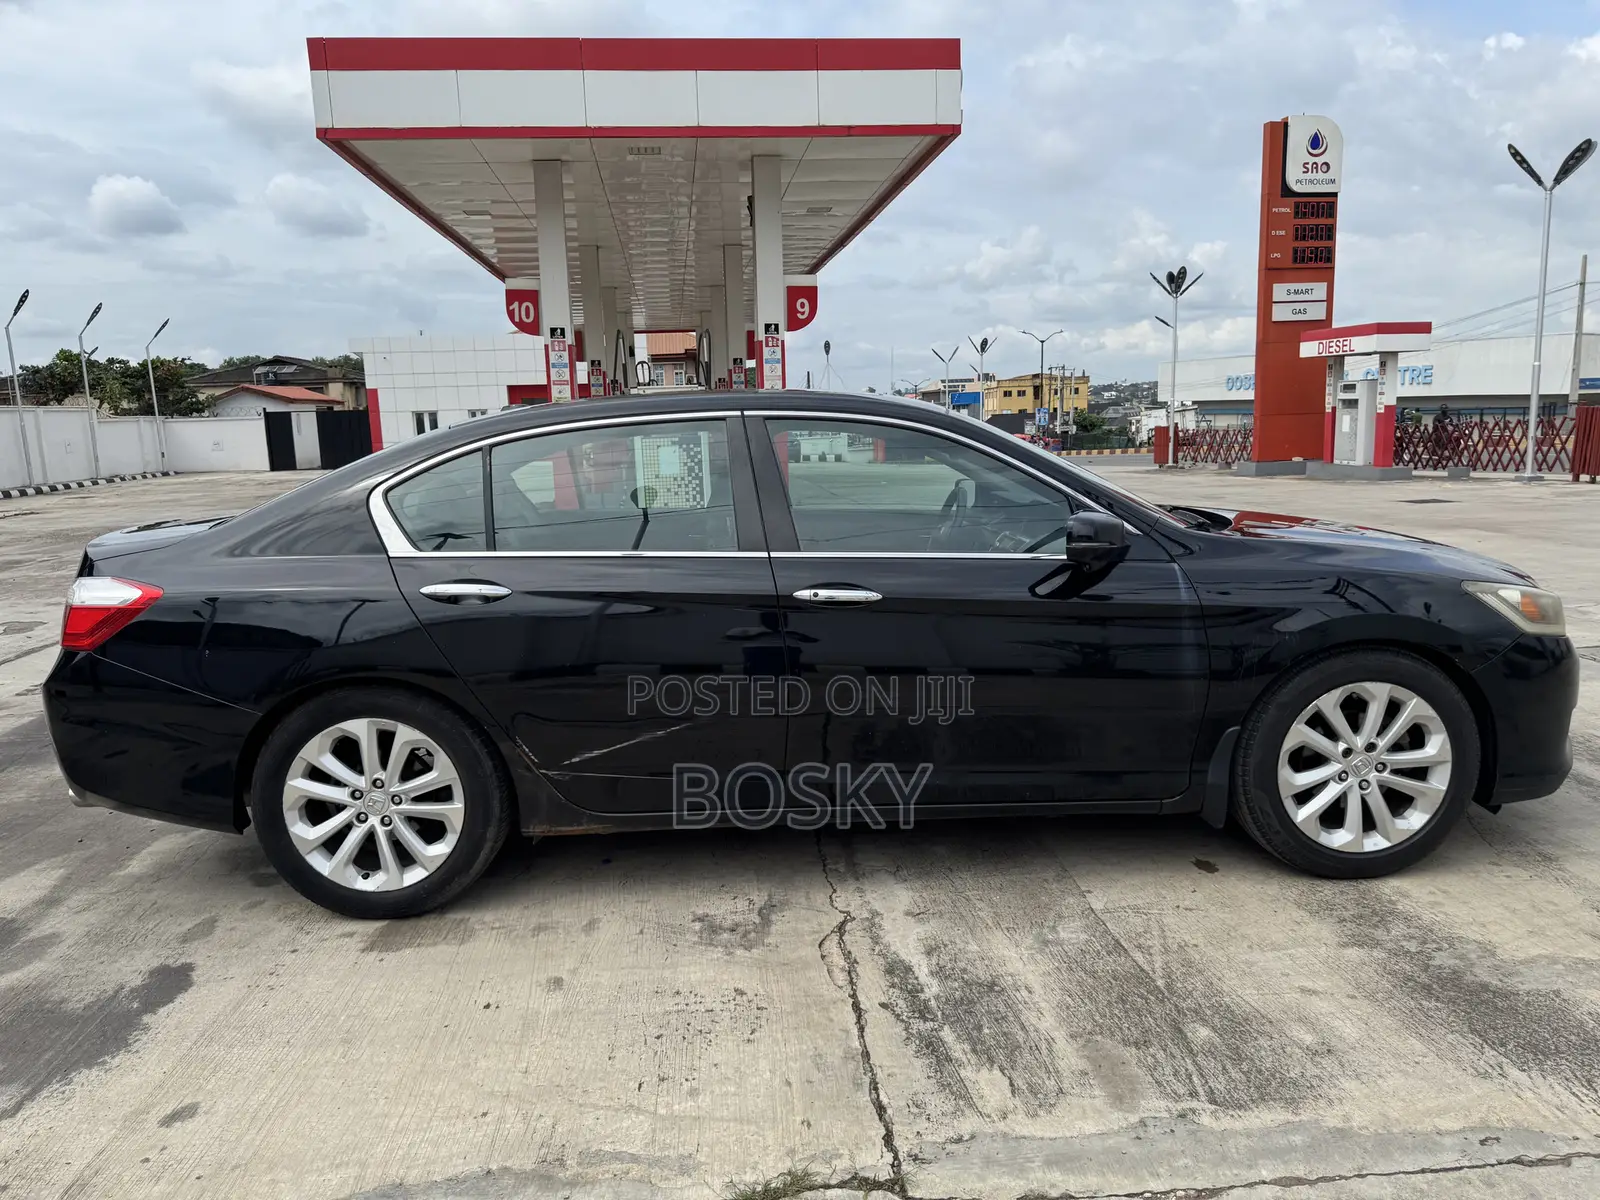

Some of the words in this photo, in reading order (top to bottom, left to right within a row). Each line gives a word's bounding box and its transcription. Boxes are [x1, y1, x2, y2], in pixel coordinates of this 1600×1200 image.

[1302, 161, 1331, 174] SAO
[1295, 178, 1336, 186] PETROLEUM
[1286, 288, 1314, 296] S-MART
[509, 301, 535, 323] 10
[796, 298, 810, 319] 9
[1291, 308, 1308, 316] GAS
[1317, 339, 1355, 355] DIESEL
